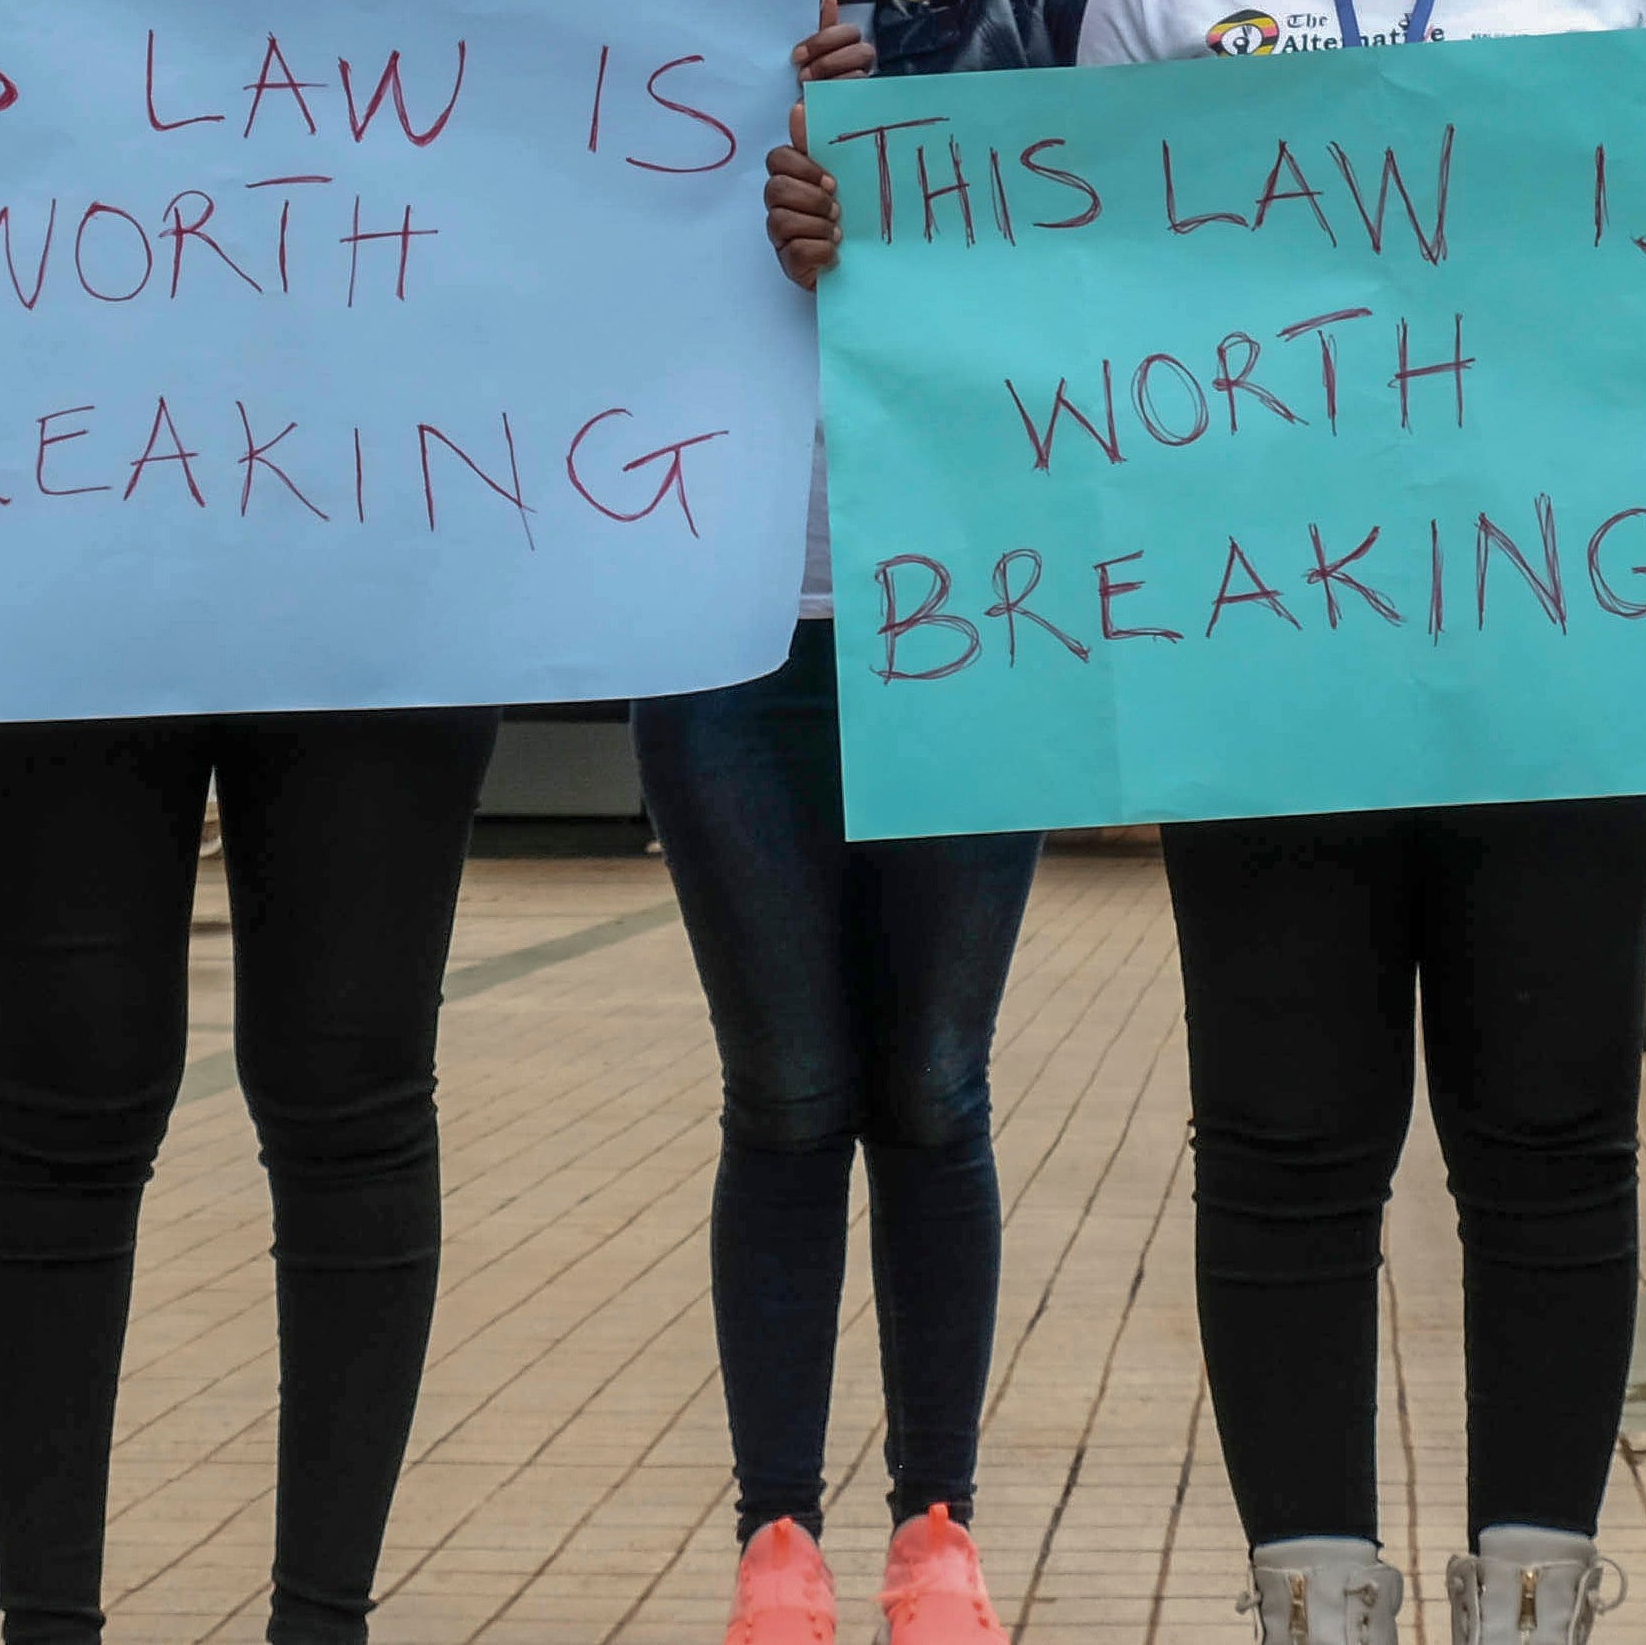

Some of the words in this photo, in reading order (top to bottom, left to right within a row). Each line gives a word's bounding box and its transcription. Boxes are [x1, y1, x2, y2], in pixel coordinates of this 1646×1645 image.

[1281, 26, 1444, 53] Altenate
[1287, 14, 1328, 29] The
[146, 29, 466, 147] LAW
[588, 45, 736, 173] IS
[829, 117, 1102, 247] THIS
[1162, 123, 1455, 266] LAW
[1004, 307, 1476, 471] WORTH
